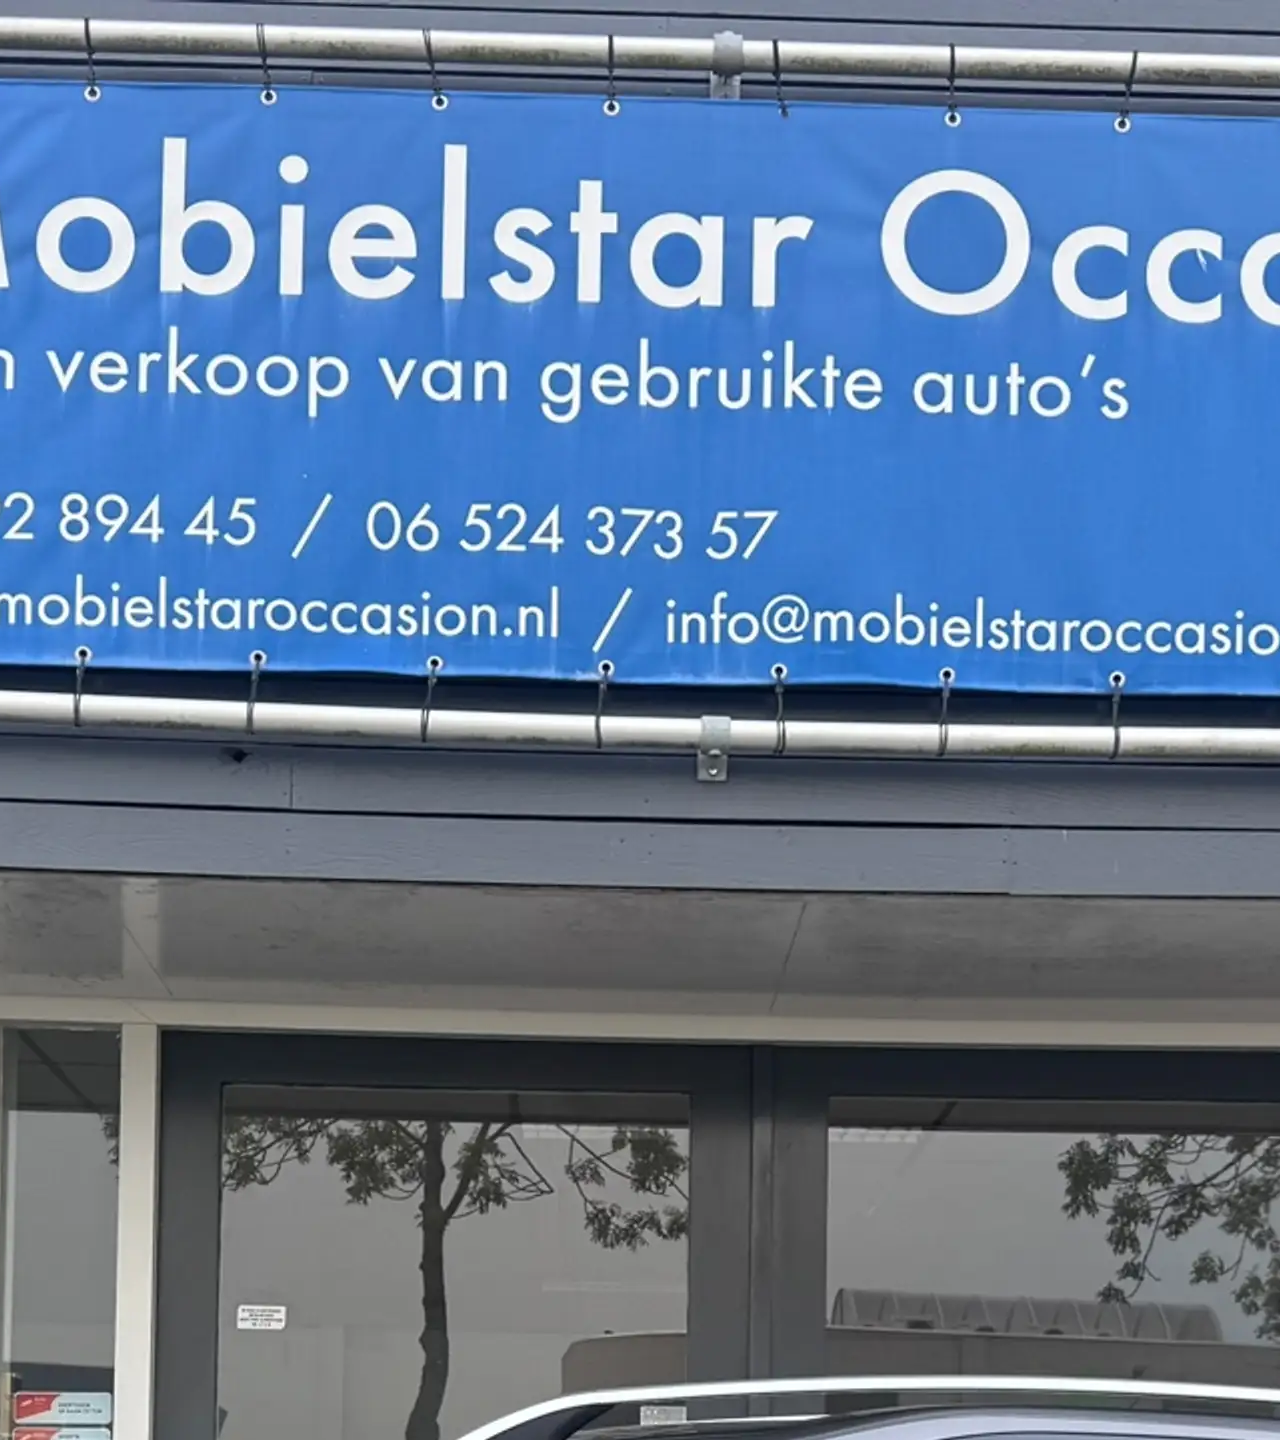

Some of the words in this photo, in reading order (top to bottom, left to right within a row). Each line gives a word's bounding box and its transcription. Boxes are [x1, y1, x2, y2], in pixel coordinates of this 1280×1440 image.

[46, 325, 349, 418] verkoop
[378, 358, 508, 402] van
[540, 337, 883, 424] gebruikte
[913, 354, 1129, 419] auto's
[59, 493, 165, 543] 894
[184, 496, 256, 546] 45
[291, 493, 332, 559] /
[366, 501, 439, 552] 06
[459, 503, 564, 553] 524
[585, 506, 683, 560] 373
[706, 510, 778, 560] 57
[592, 588, 633, 653] /
